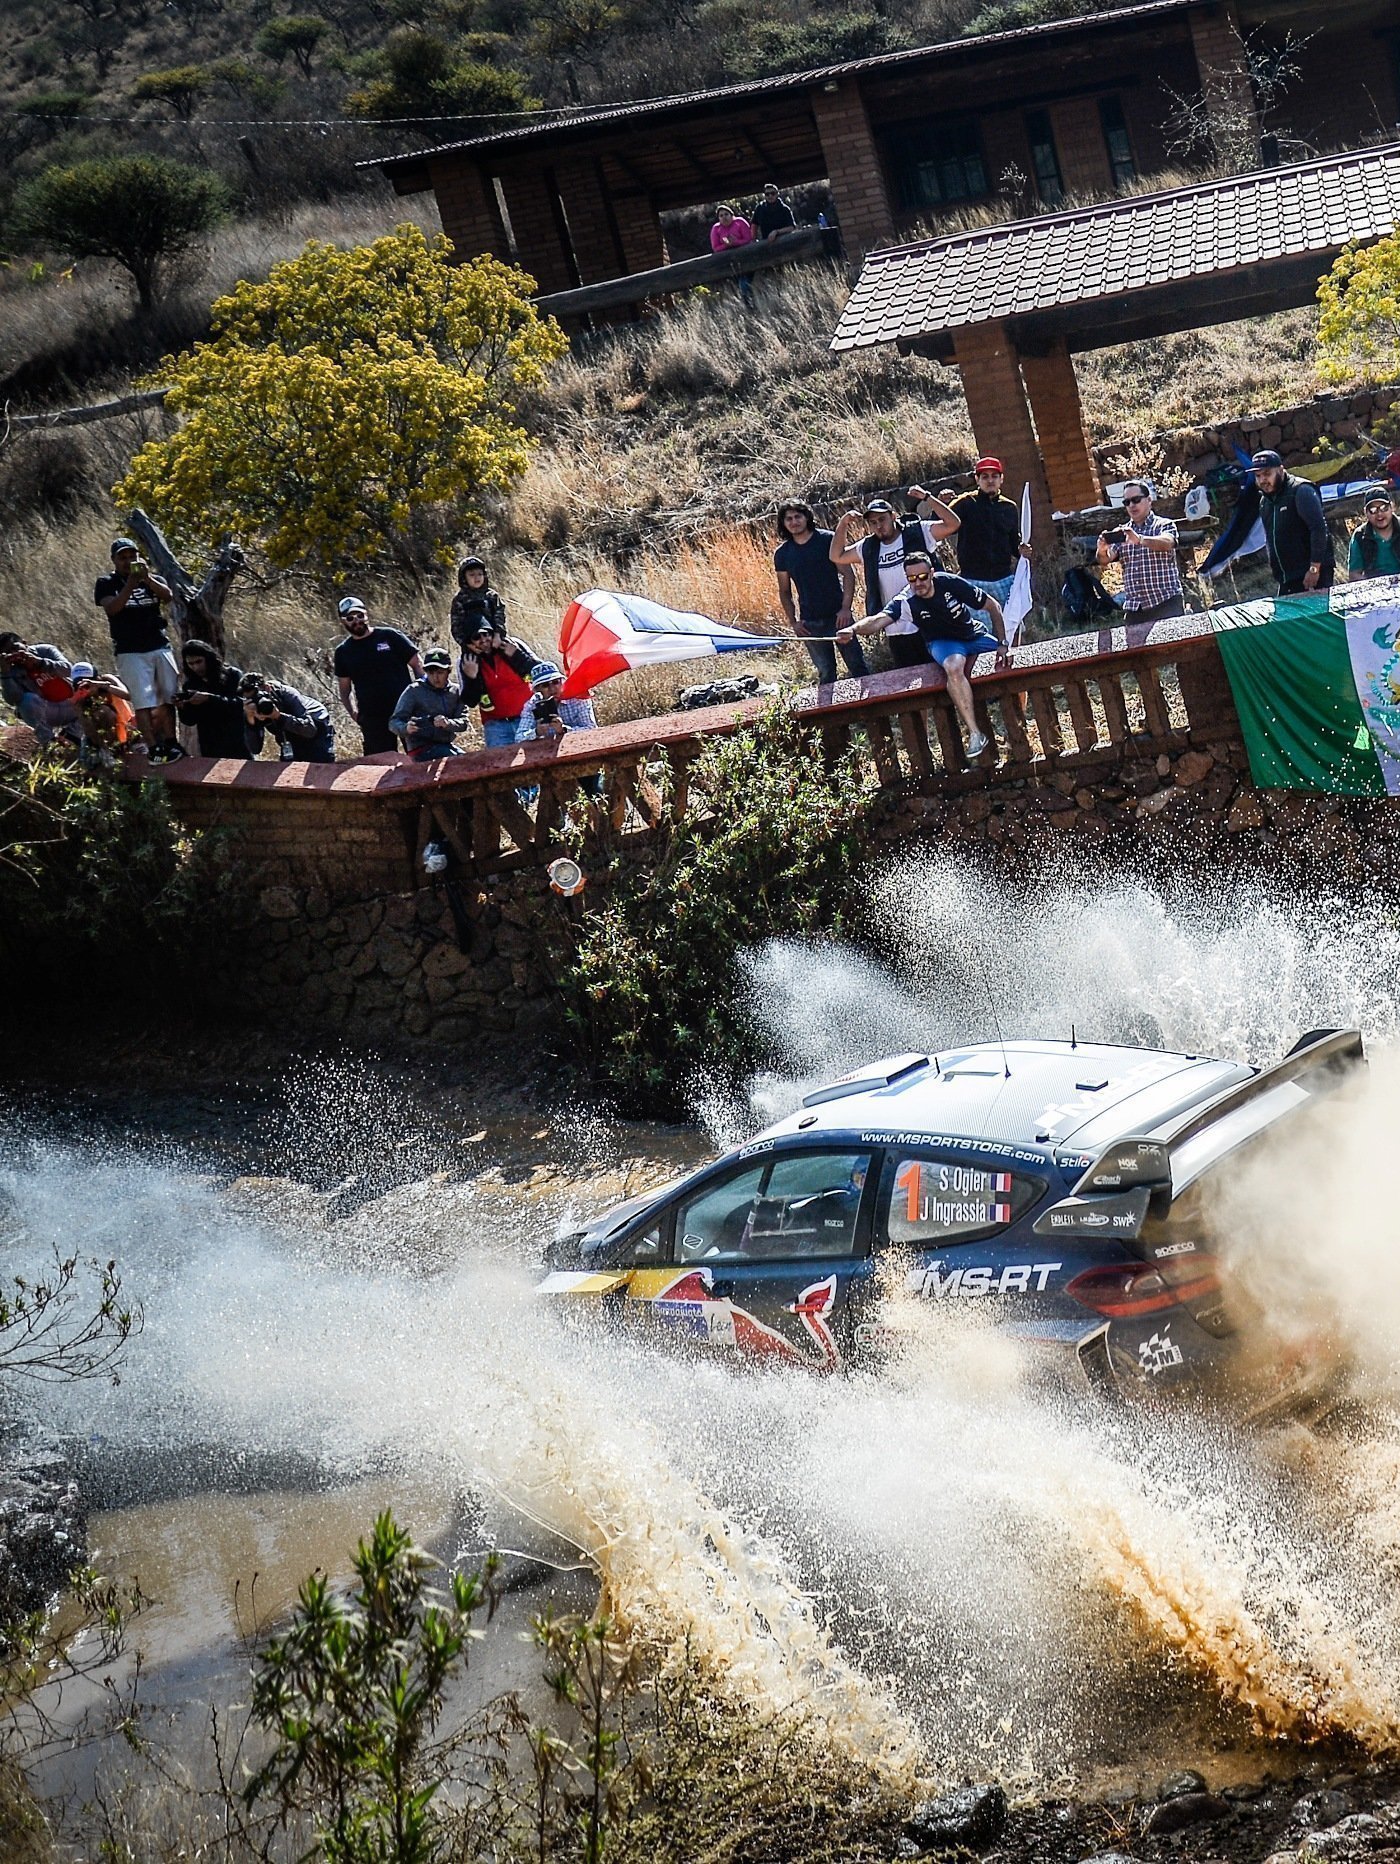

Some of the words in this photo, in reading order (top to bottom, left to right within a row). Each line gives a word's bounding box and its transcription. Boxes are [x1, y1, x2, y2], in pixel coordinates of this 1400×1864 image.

[861, 1133, 1045, 1165] www.MSPORTSTORE.com
[1060, 1155, 1090, 1168] Stilo
[898, 1163, 920, 1222] 1
[940, 1166, 949, 1191] S
[953, 1167, 987, 1197] Ogier
[920, 1196, 929, 1221] J
[933, 1196, 986, 1227] Ingrassia
[1155, 1241, 1195, 1258] sparco
[921, 1262, 1062, 1299] MS-RT
